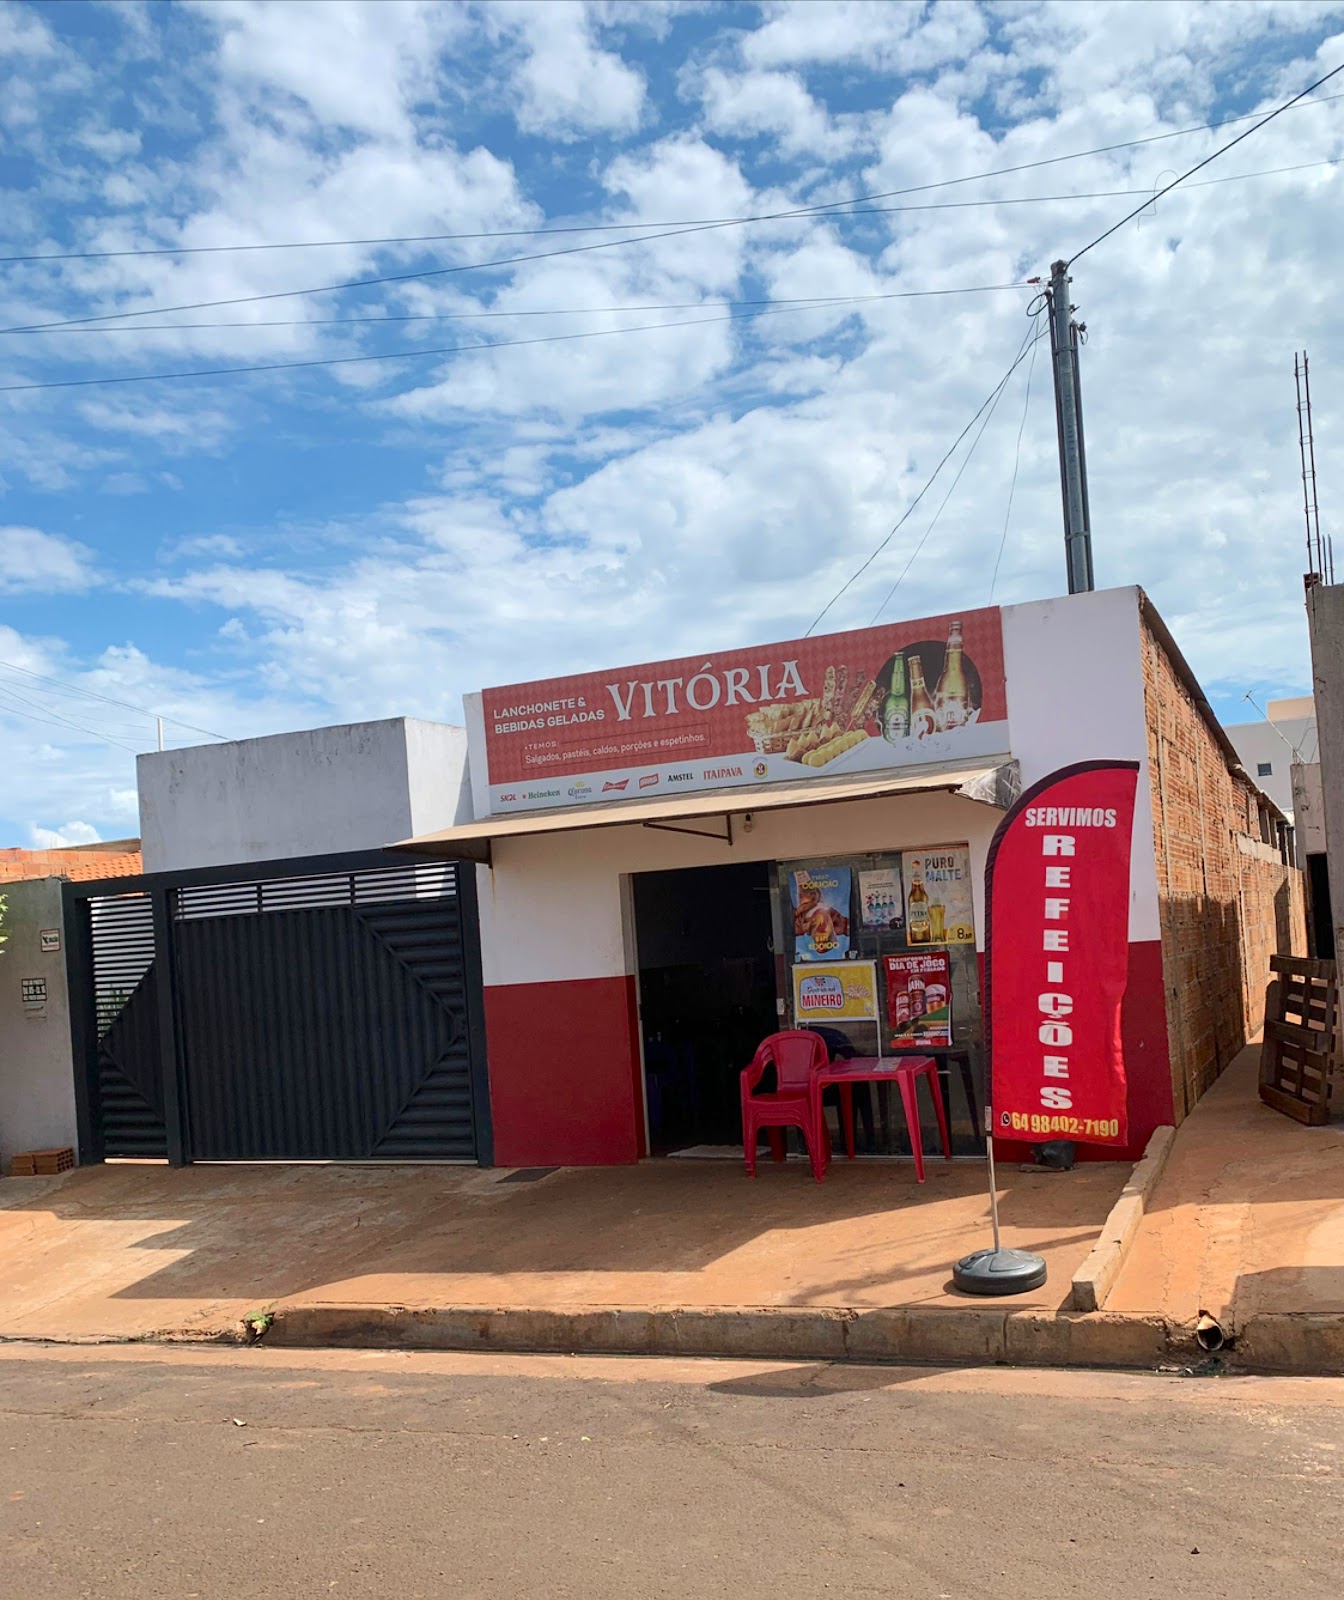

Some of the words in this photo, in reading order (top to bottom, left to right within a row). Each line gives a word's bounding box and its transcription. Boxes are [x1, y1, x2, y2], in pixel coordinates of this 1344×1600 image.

[605, 659, 809, 721] VITÓRIA
[493, 698, 575, 719] LANCHONETE
[577, 697, 586, 707] &
[494, 718, 545, 734] BEBIDAS
[547, 709, 605, 727] GELADAS
[525, 752, 561, 765] Salgados,
[562, 748, 592, 761] pastéis,
[593, 744, 620, 755] caldos,
[620, 740, 652, 754] porções
[653, 739, 659, 747] e
[660, 733, 705, 747] espetinhos.
[667, 772, 694, 782] AMSTEL
[703, 766, 743, 780] ITAIPAVA
[528, 789, 560, 800] Heineken
[1025, 806, 1117, 828] SERVIMOS
[924, 856, 955, 870] PURO
[925, 869, 962, 882] MALTE
[889, 961, 906, 970] DIA
[906, 960, 919, 969] DE
[1038, 834, 1076, 1110] REFEIÇÕES
[801, 993, 842, 1007] MINEIRO
[1011, 1112, 1029, 1131] 64
[1030, 1114, 1119, 1137] 98402-7190
